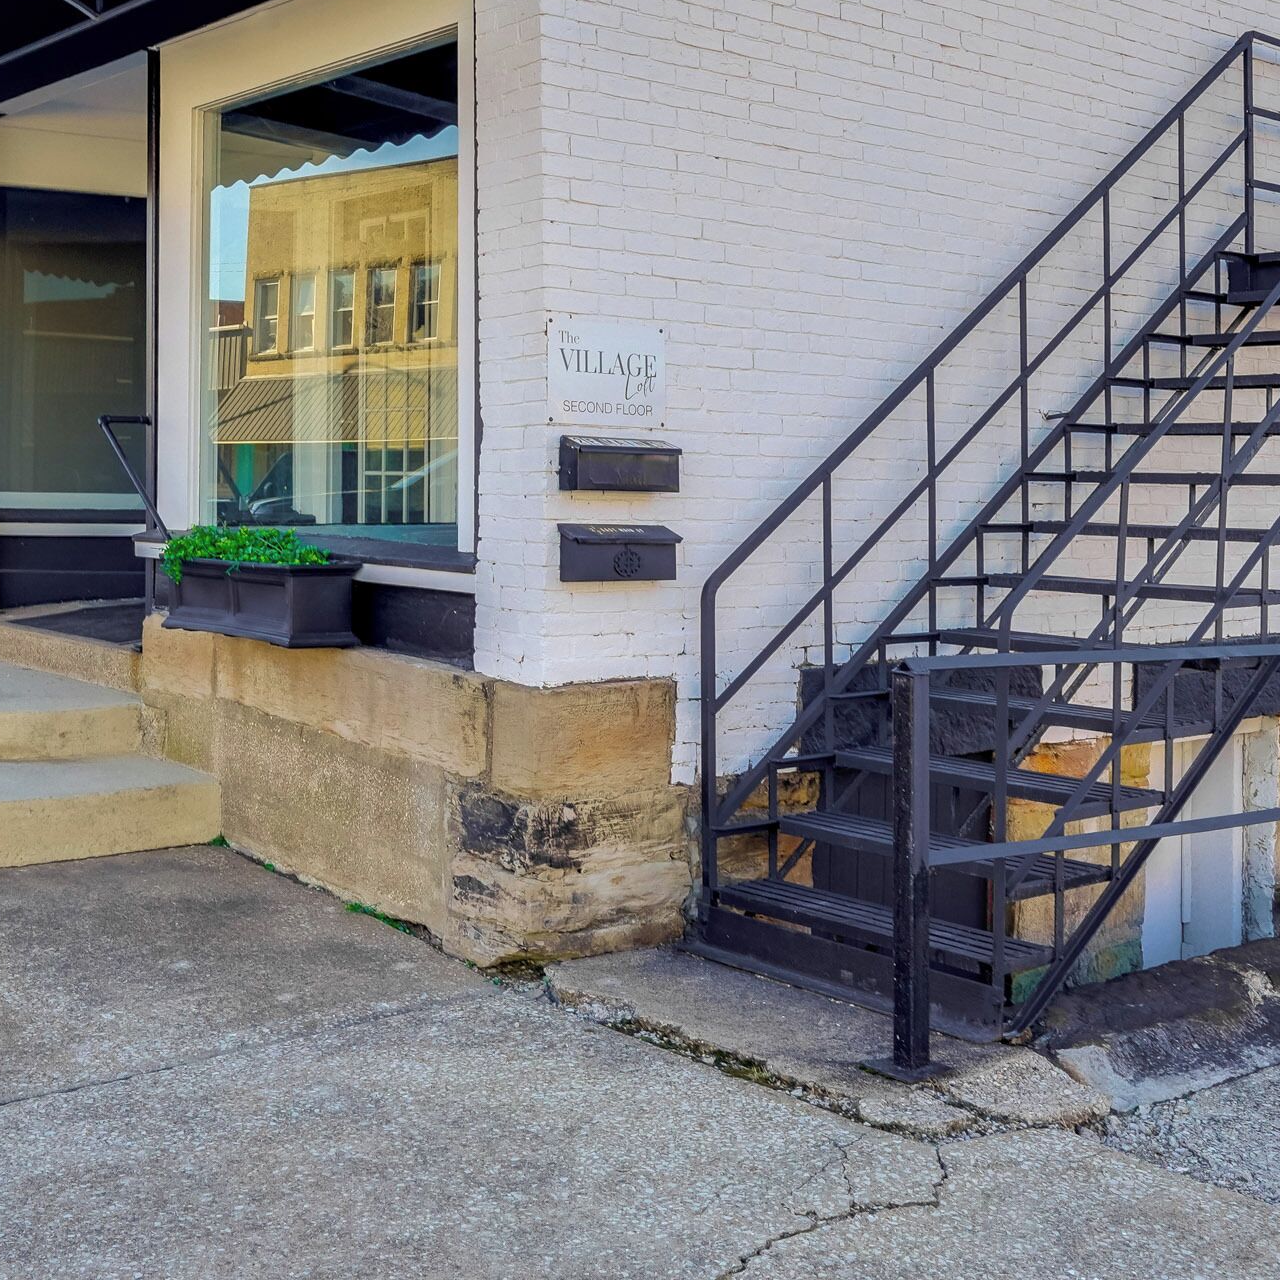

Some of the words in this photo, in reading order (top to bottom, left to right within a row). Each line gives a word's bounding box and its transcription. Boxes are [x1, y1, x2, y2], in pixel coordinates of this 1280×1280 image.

[558, 330, 580, 344] The
[559, 347, 657, 378] VILLAGE
[624, 372, 657, 401] Loft
[562, 399, 613, 414] SECOND
[615, 403, 654, 417] FLOOR
